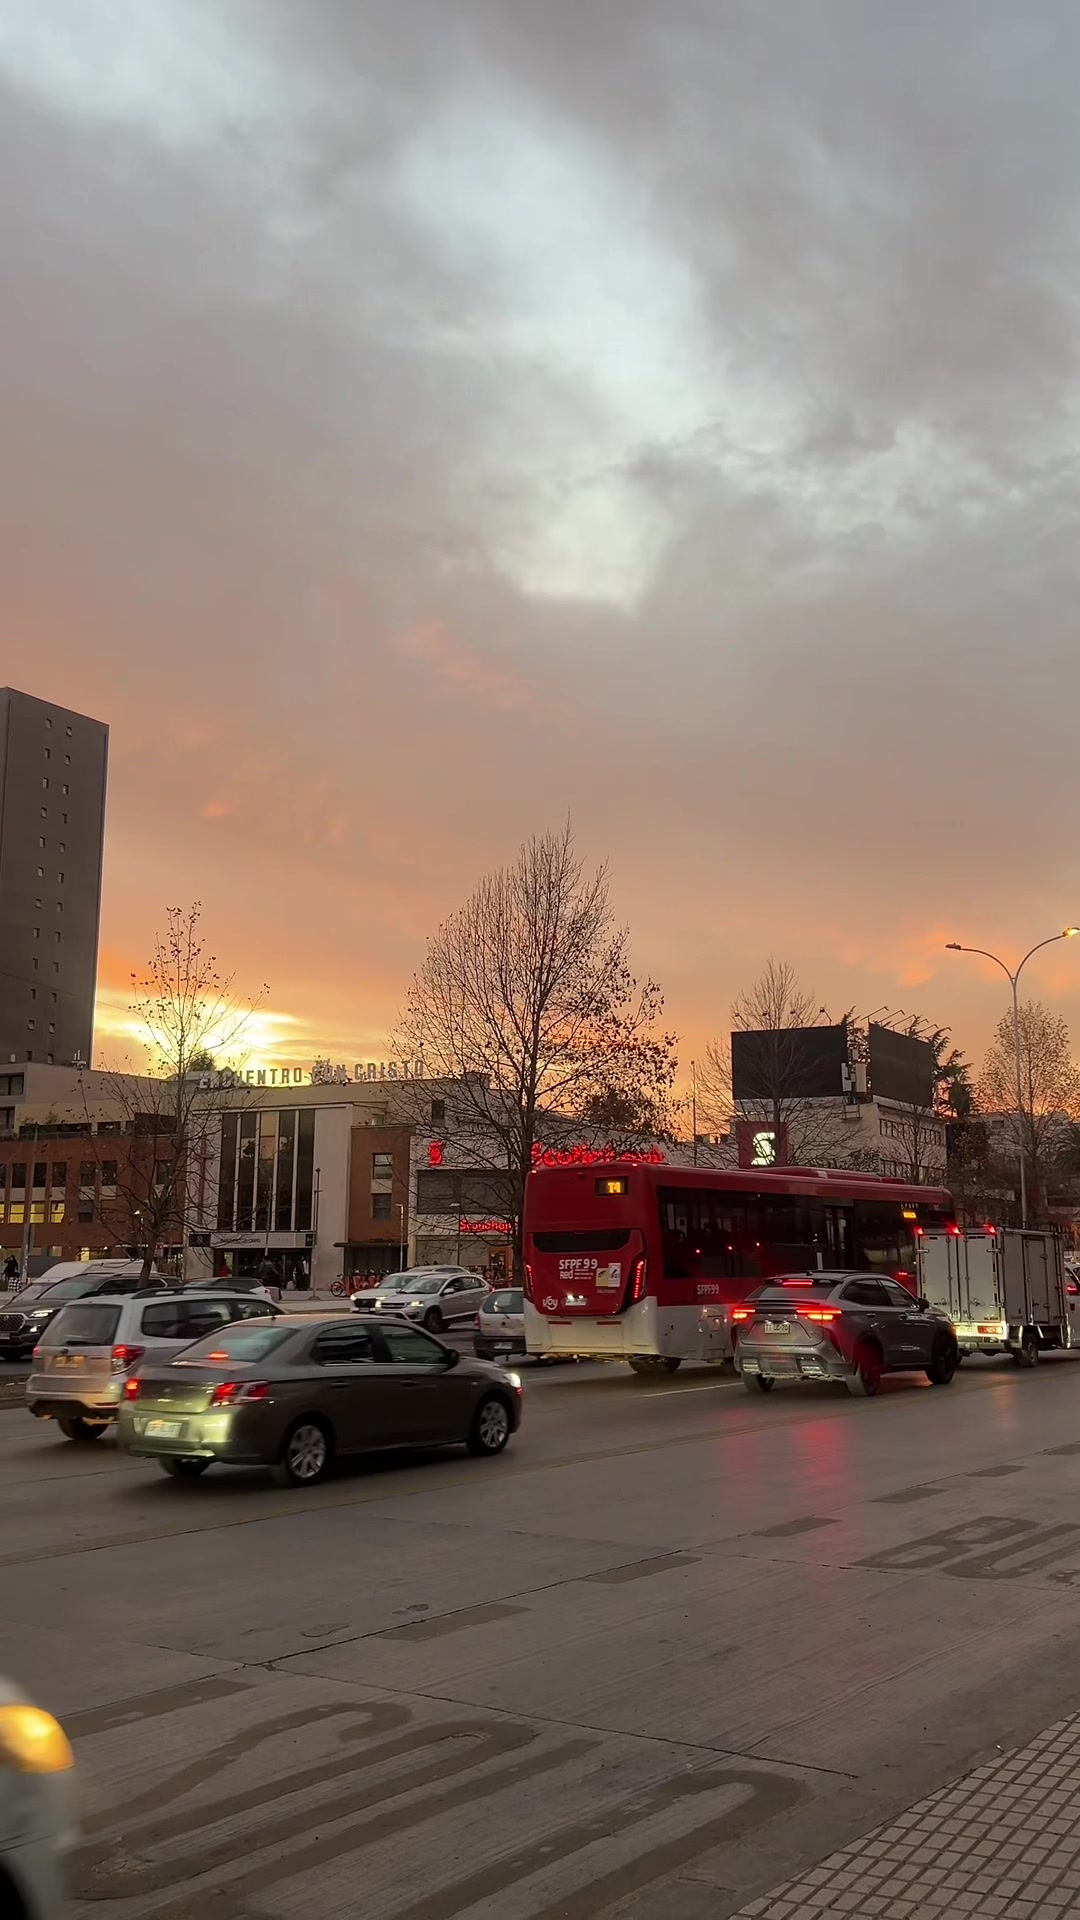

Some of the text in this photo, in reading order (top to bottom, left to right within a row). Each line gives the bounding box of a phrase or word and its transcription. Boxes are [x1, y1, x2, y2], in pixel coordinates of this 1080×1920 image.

[200, 1060, 424, 1089] ENCUENTRO CON CRISTO
